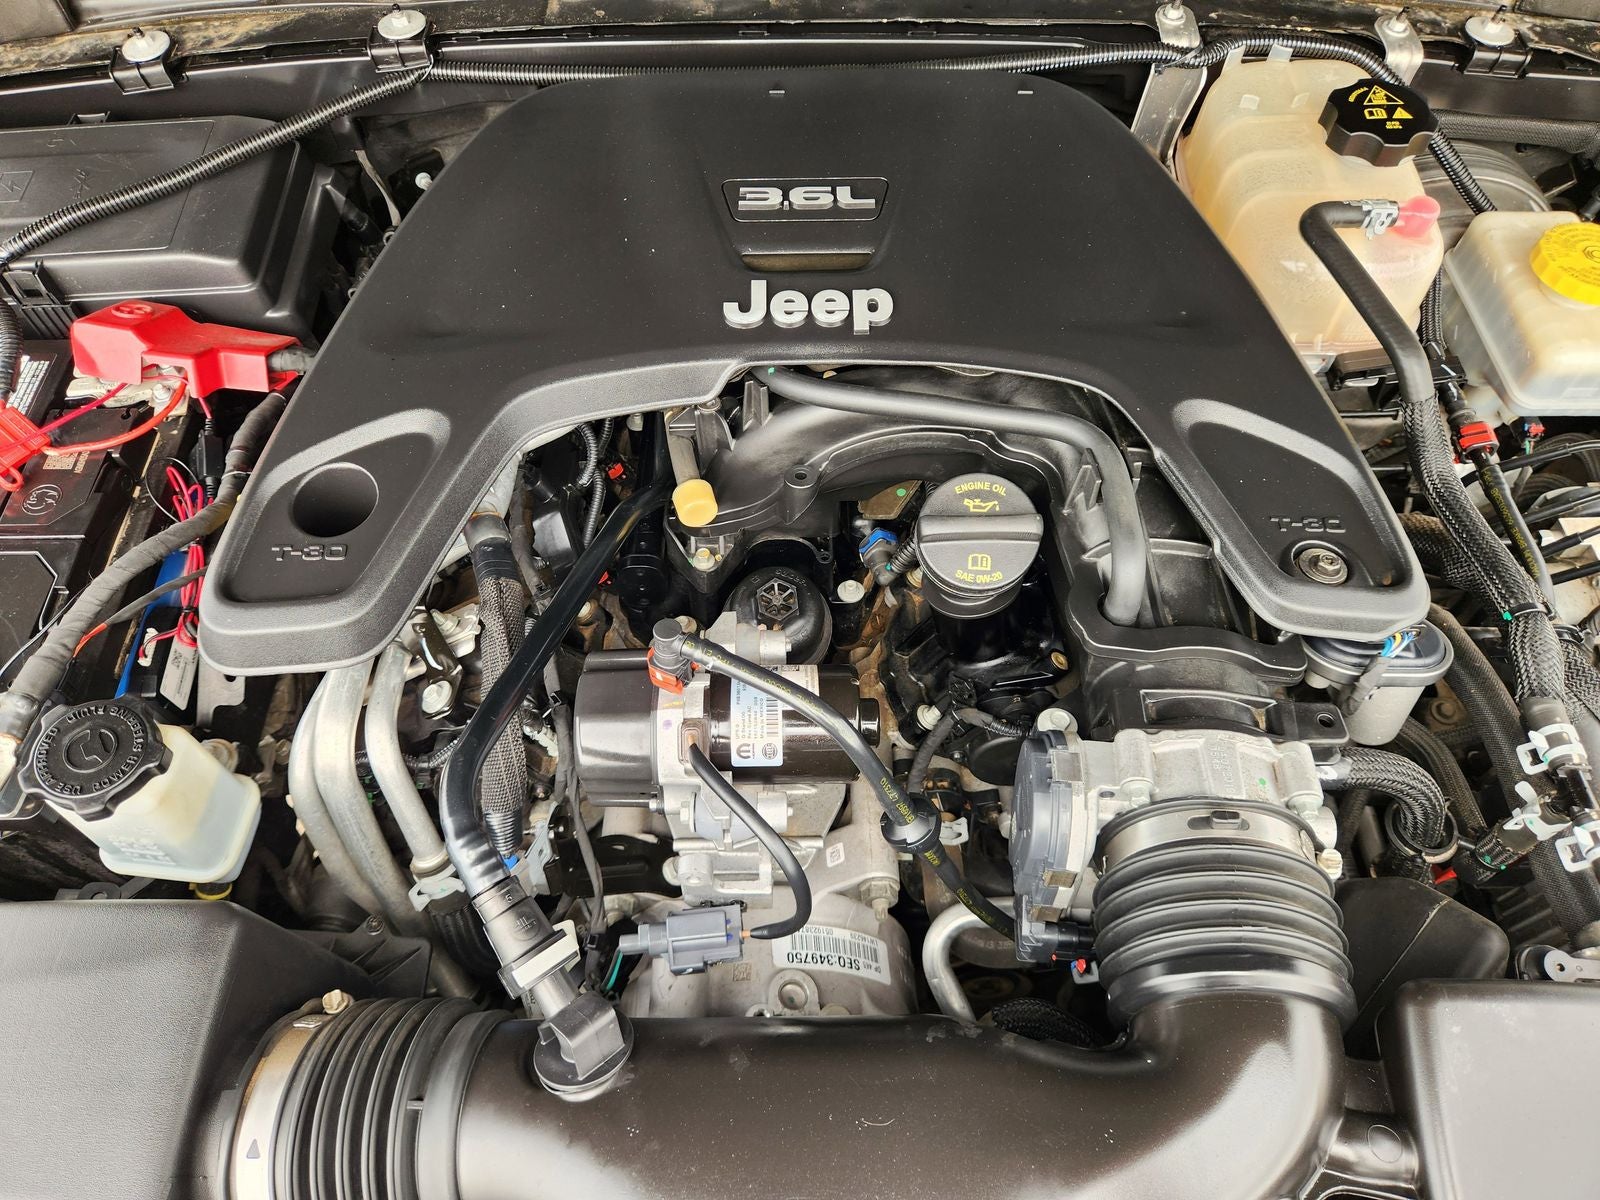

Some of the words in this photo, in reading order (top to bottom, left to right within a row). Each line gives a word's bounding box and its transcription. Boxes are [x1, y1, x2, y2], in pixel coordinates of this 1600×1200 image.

[737, 186, 876, 211] 3.6L
[723, 279, 894, 335] Jeep
[955, 481, 991, 495] ENGINE
[992, 483, 1007, 496] OIL
[271, 544, 348, 562] T-30
[955, 569, 974, 583] SAE
[975, 571, 1004, 584] 0W-20
[65, 704, 107, 724] FLUID
[108, 705, 147, 753] STEERING
[36, 726, 59, 786] APPROVED
[92, 754, 139, 794] POWER
[54, 784, 82, 796] USE
[787, 951, 860, 971] SEQ:349750
